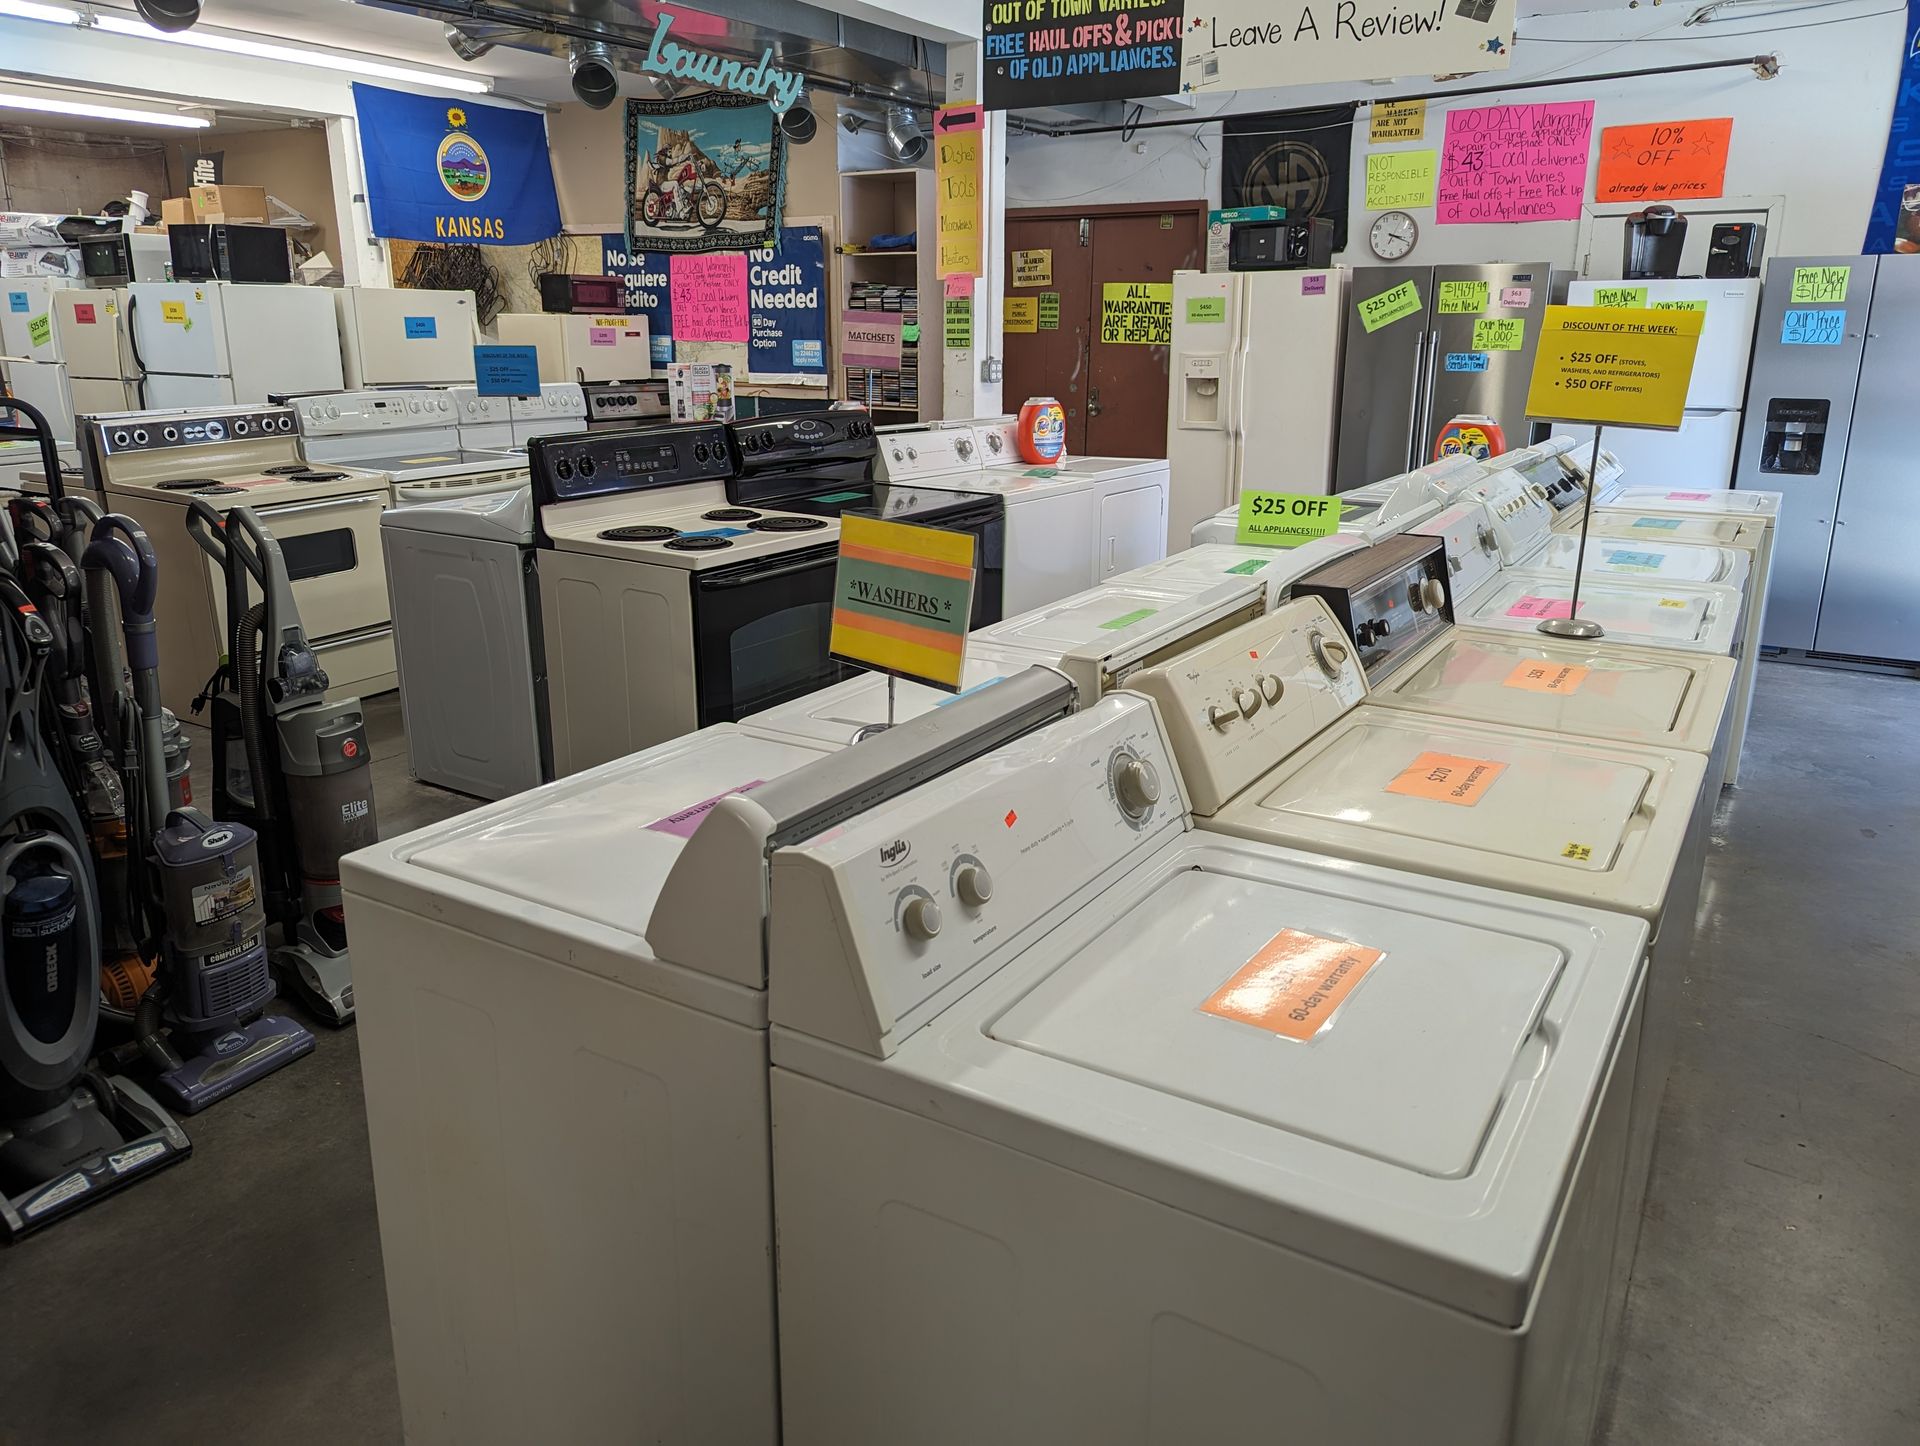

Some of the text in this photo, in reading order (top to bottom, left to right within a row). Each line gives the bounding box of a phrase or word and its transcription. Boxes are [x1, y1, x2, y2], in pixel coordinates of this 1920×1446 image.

[992, 2, 1021, 25] OUT
[1025, 0, 1045, 20] OF
[1211, 0, 1447, 48] Leave A Review!
[986, 32, 1025, 57] FREE
[1029, 27, 1070, 52] HAUL
[1073, 23, 1113, 48] OFFS
[1114, 13, 1132, 47] &
[1135, 16, 1173, 43] PICK
[642, 12, 805, 114] Laundry
[1009, 46, 1177, 80] OF OLD APPLIANCES.
[1376, 117, 1408, 127] ARE NOT
[1451, 103, 1593, 139] 60 DAY Warranty
[1452, 140, 1487, 153] Repair
[1503, 138, 1543, 151] Replace
[1547, 135, 1578, 147] ONLY
[1473, 131, 1491, 143] On
[1498, 129, 1527, 142] Large
[1650, 126, 1686, 147] 10%
[941, 142, 975, 164] Dishes
[1531, 150, 1586, 167] deliveries
[1637, 149, 1681, 167] OFF
[1369, 155, 1395, 172] NOT
[1368, 167, 1429, 182] RESPONSIBLE
[1489, 171, 1522, 185] Town
[1525, 169, 1565, 184] Varies
[941, 175, 976, 200] Tools
[1368, 184, 1386, 195] FOR
[1439, 188, 1459, 202] Free
[1462, 188, 1480, 200] Haul
[1518, 185, 1543, 199] Free
[1609, 181, 1707, 198] already low prices
[1367, 192, 1425, 207] ACCIDENTS!!
[1447, 201, 1556, 220] of old Appliances
[435, 216, 504, 239] KANSAS
[607, 250, 627, 267] No
[608, 270, 667, 291] quiere
[750, 264, 802, 286] Credit
[1821, 267, 1847, 284] New
[751, 288, 818, 309] Needed
[1126, 285, 1150, 299] ALL
[1366, 286, 1408, 314] $25 OFF
[1503, 299, 1526, 307] Delivery
[763, 318, 777, 328] Day
[1104, 315, 1128, 329] ARE
[1480, 320, 1495, 330] Our
[1562, 321, 1678, 334] DISCOUNT OF THE WEEK:
[752, 329, 783, 338] Purchase
[848, 330, 896, 344] MATCHSETS
[1103, 328, 1120, 342] OR
[753, 338, 777, 349] Option
[1570, 351, 1592, 363] $25
[1595, 353, 1618, 364] OFF
[1561, 367, 1592, 375] WASHERS,
[1608, 370, 1660, 379] REFRIGERATORS)
[1565, 377, 1643, 393] $50 OFF (DRYERS)
[1443, 443, 1461, 457] Tide
[1251, 495, 1329, 517] $25 OFF
[1248, 524, 1261, 532] ALL
[1425, 766, 1453, 783] $270
[1466, 764, 1489, 786] warranty
[341, 799, 368, 815] Elite
[207, 833, 228, 846] Shark
[880, 839, 907, 863] Inglis
[973, 925, 997, 945] temperature
[209, 946, 242, 964] COMPLETE
[45, 942, 59, 993] ORECK
[921, 963, 942, 980] load size
[1288, 990, 1328, 1022] 60-day
[1319, 955, 1361, 996] warranty
